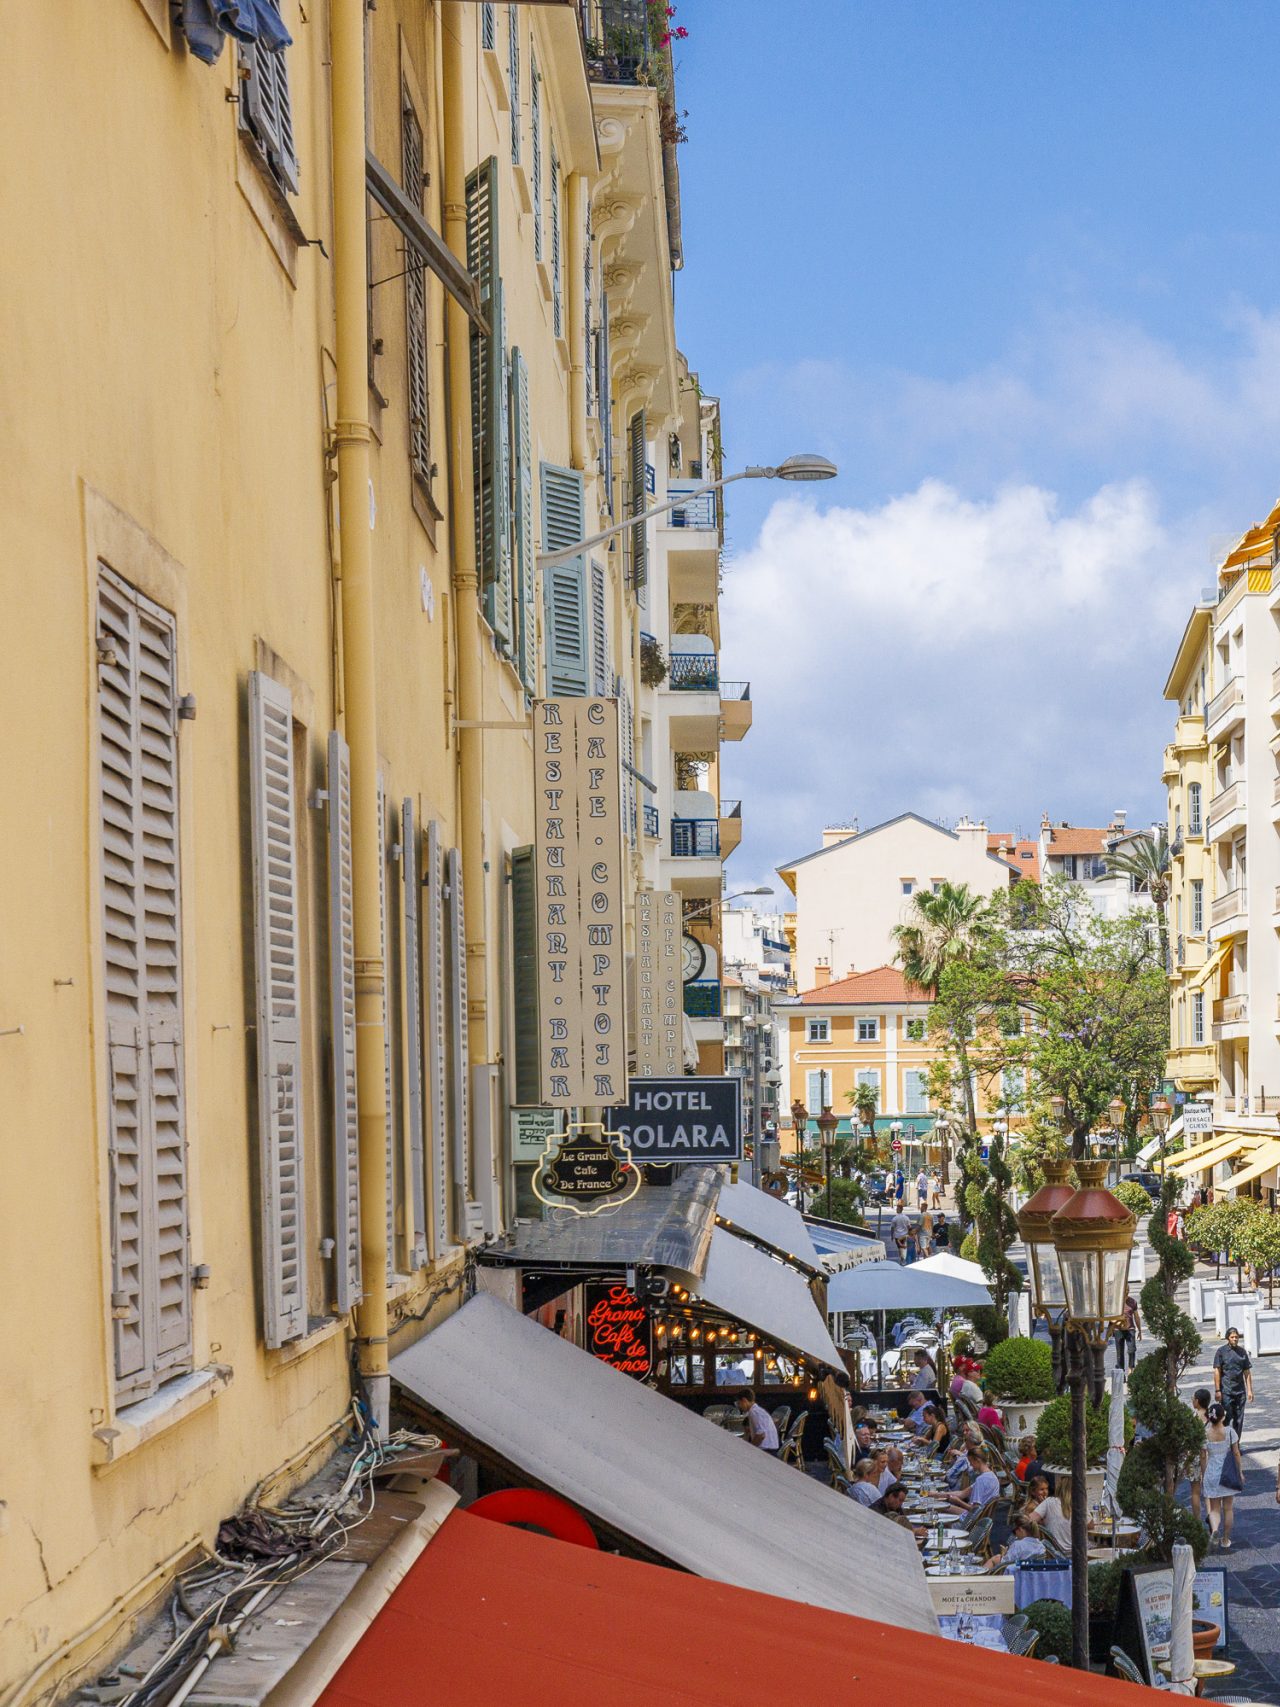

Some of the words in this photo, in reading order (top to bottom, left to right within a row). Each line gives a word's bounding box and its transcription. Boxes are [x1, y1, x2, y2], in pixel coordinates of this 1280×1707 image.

[587, 703, 606, 818] CAFE
[543, 703, 567, 982] RESTAURANT
[664, 894, 676, 957] CAFE
[640, 894, 653, 1046] RESTAURANT
[549, 1018, 570, 1097] BAR
[664, 979, 678, 1075] COMPTO
[634, 1091, 712, 1111] HOTEL
[561, 1152, 575, 1162] Le
[577, 1151, 609, 1162] Grand
[617, 1124, 730, 1149] SOLARA
[560, 1180, 575, 1190] De
[577, 1179, 612, 1190] France
[626, 1339, 647, 1357] de
